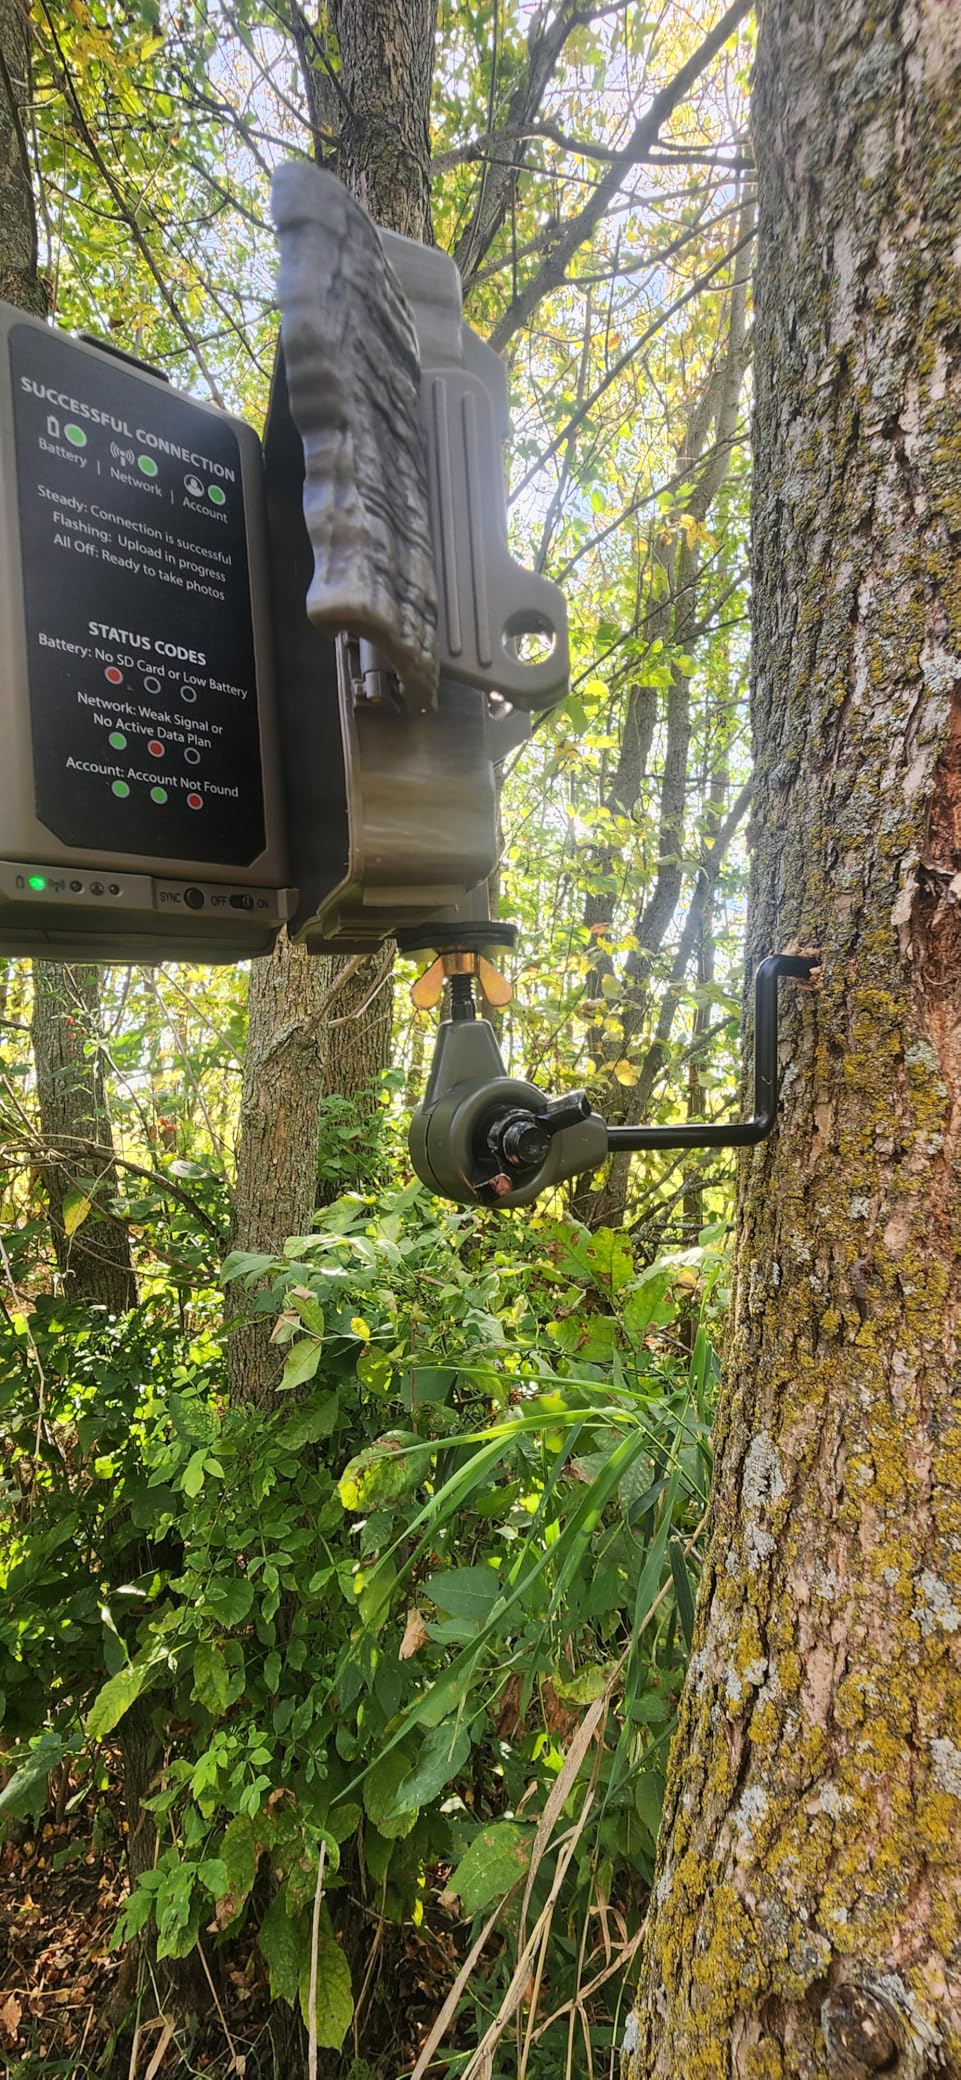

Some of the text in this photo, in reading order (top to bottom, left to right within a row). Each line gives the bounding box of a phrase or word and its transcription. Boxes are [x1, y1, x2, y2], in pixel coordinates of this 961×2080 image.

[20, 376, 235, 482] SUCCESSFUL CONNECTION
[39, 437, 228, 523] Battery Network Account
[38, 485, 232, 565] Steady: Connection is successful
[53, 512, 226, 582] Flashing: Upload in progress
[54, 533, 224, 600] All Off: Ready to take photos
[88, 621, 206, 665] STATUS CODES
[39, 633, 248, 699] Battery: No SD Card or Low Battery
[78, 692, 223, 735] Network: Weak Signal or
[94, 713, 211, 748] No Active Data Plan
[66, 756, 238, 797] Account: Account Not Found
[160, 892, 181, 903] SYNC
[211, 896, 228, 906] OFF
[257, 899, 269, 908] ON
